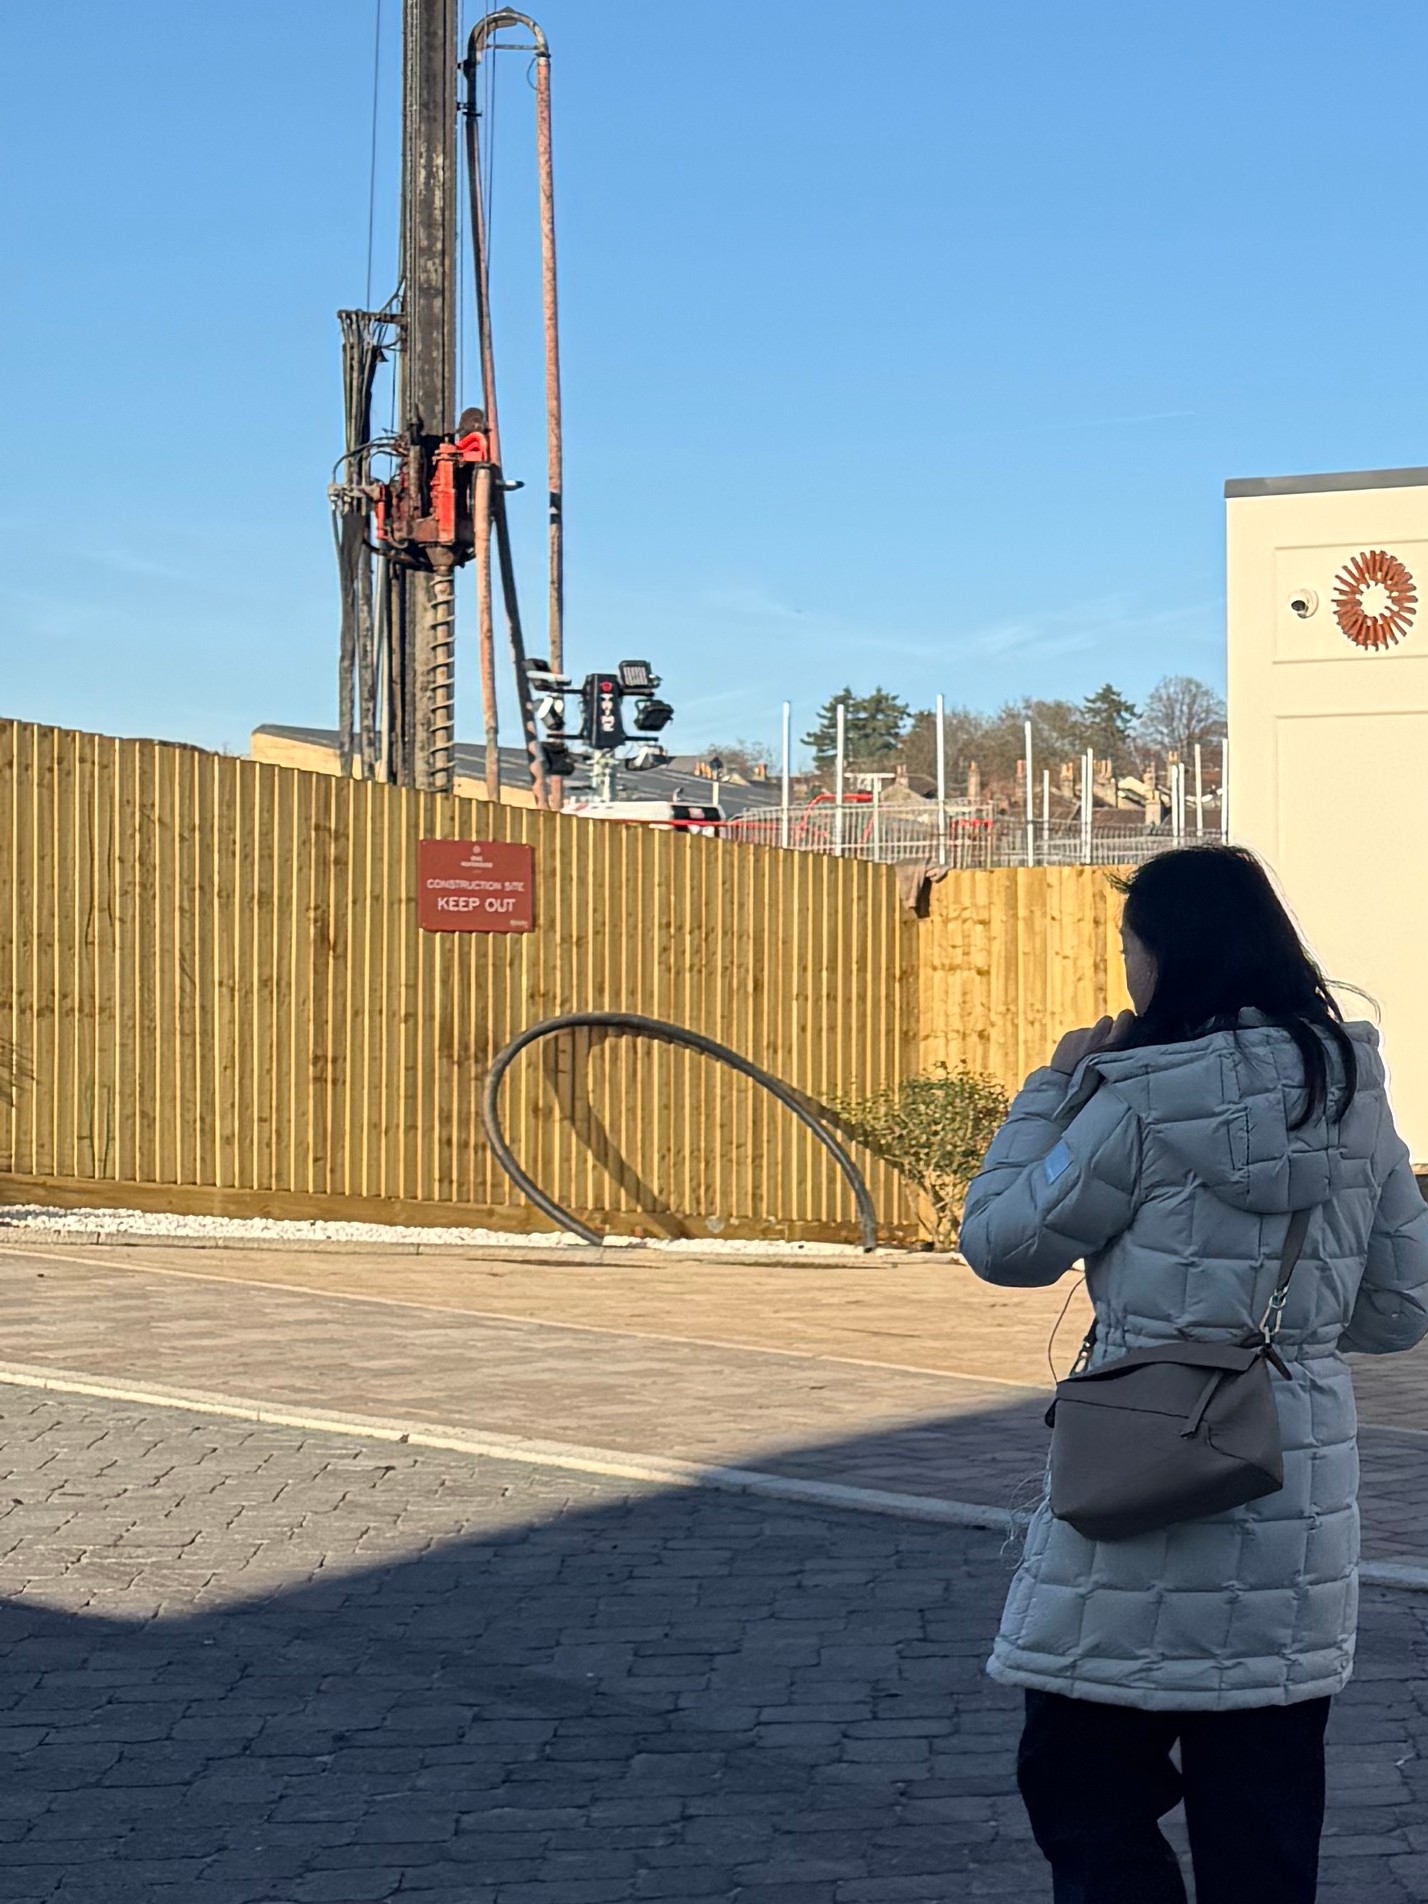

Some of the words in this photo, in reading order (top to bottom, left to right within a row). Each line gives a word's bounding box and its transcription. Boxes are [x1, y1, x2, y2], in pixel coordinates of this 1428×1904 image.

[426, 879, 502, 890] CONSTRUCTION
[437, 897, 480, 911] KEEP
[484, 898, 516, 912] OUT
